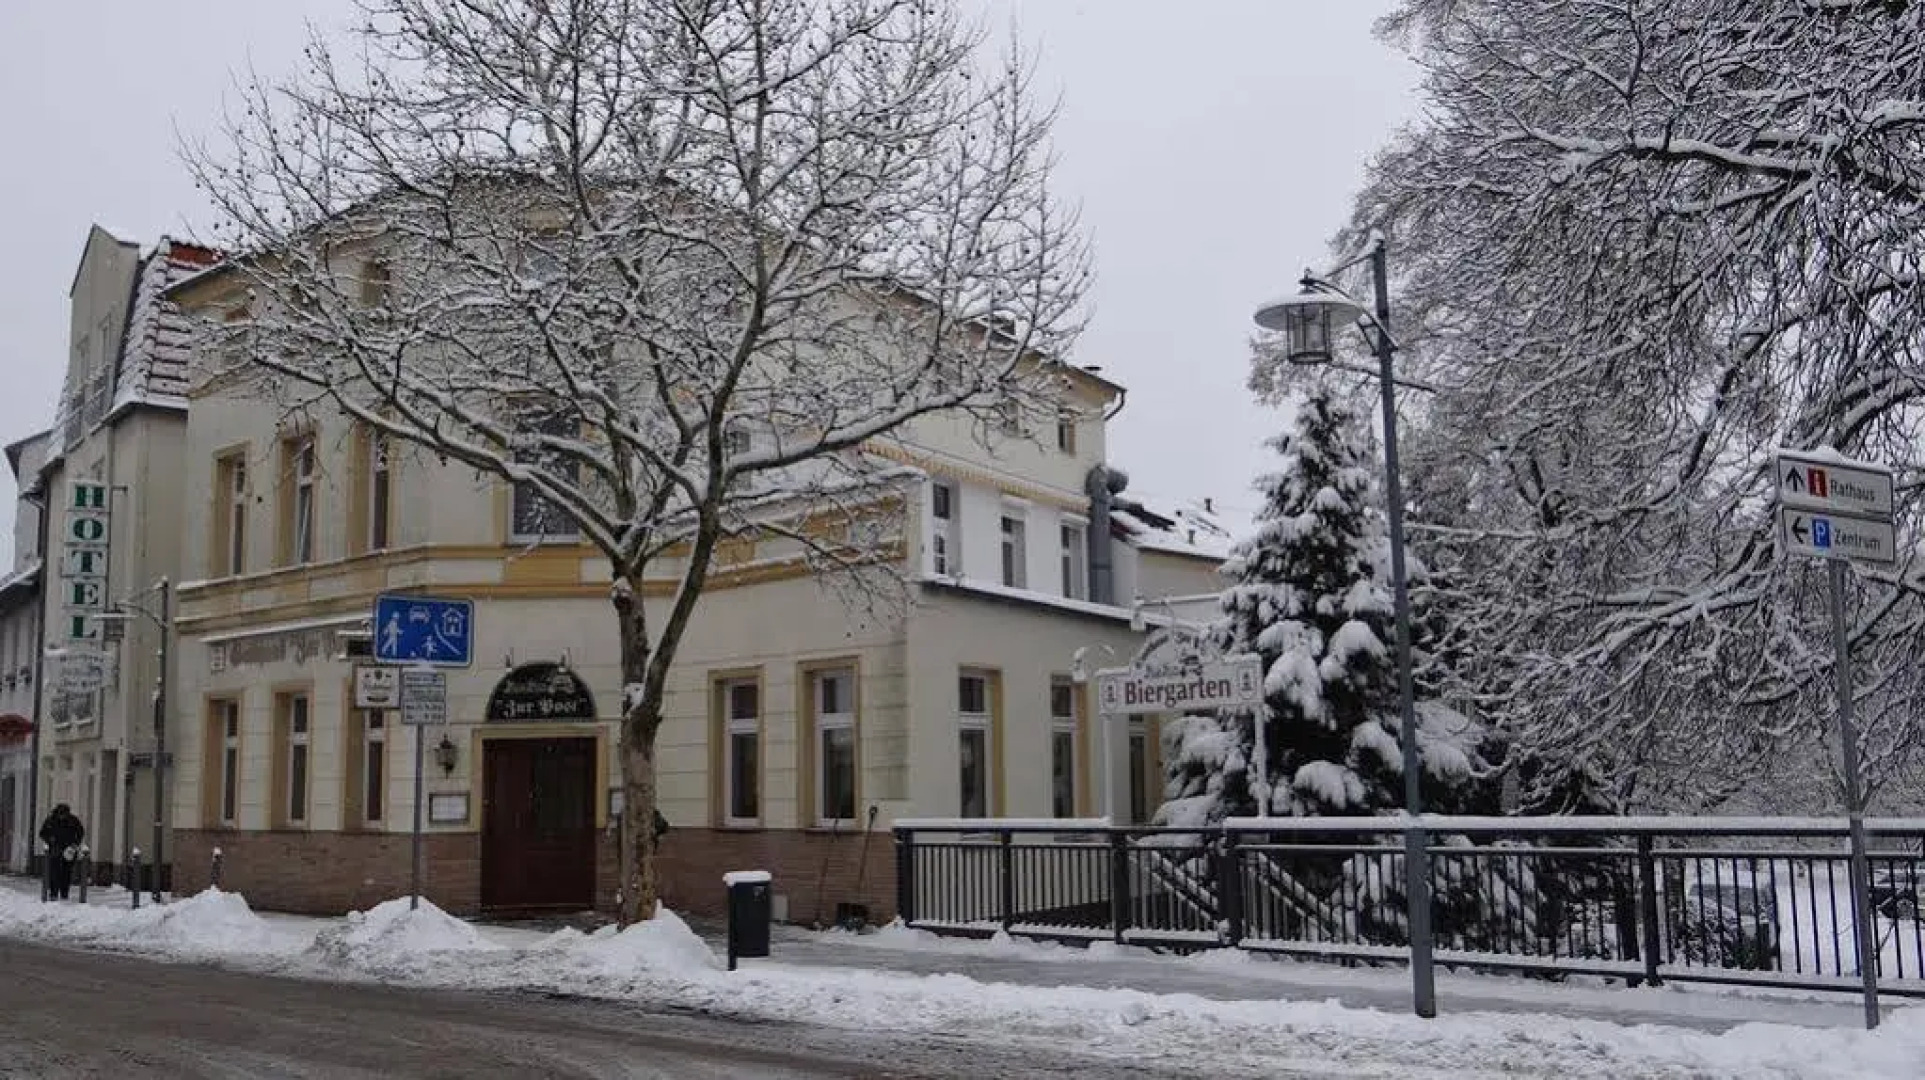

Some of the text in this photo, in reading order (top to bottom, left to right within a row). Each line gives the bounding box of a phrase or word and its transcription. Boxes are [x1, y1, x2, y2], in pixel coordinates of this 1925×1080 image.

[1829, 479, 1876, 503] Rathaus
[1815, 522, 1881, 552] P Zentrum
[71, 485, 105, 639] HOTEL
[1124, 677, 1232, 708] Biergarten
